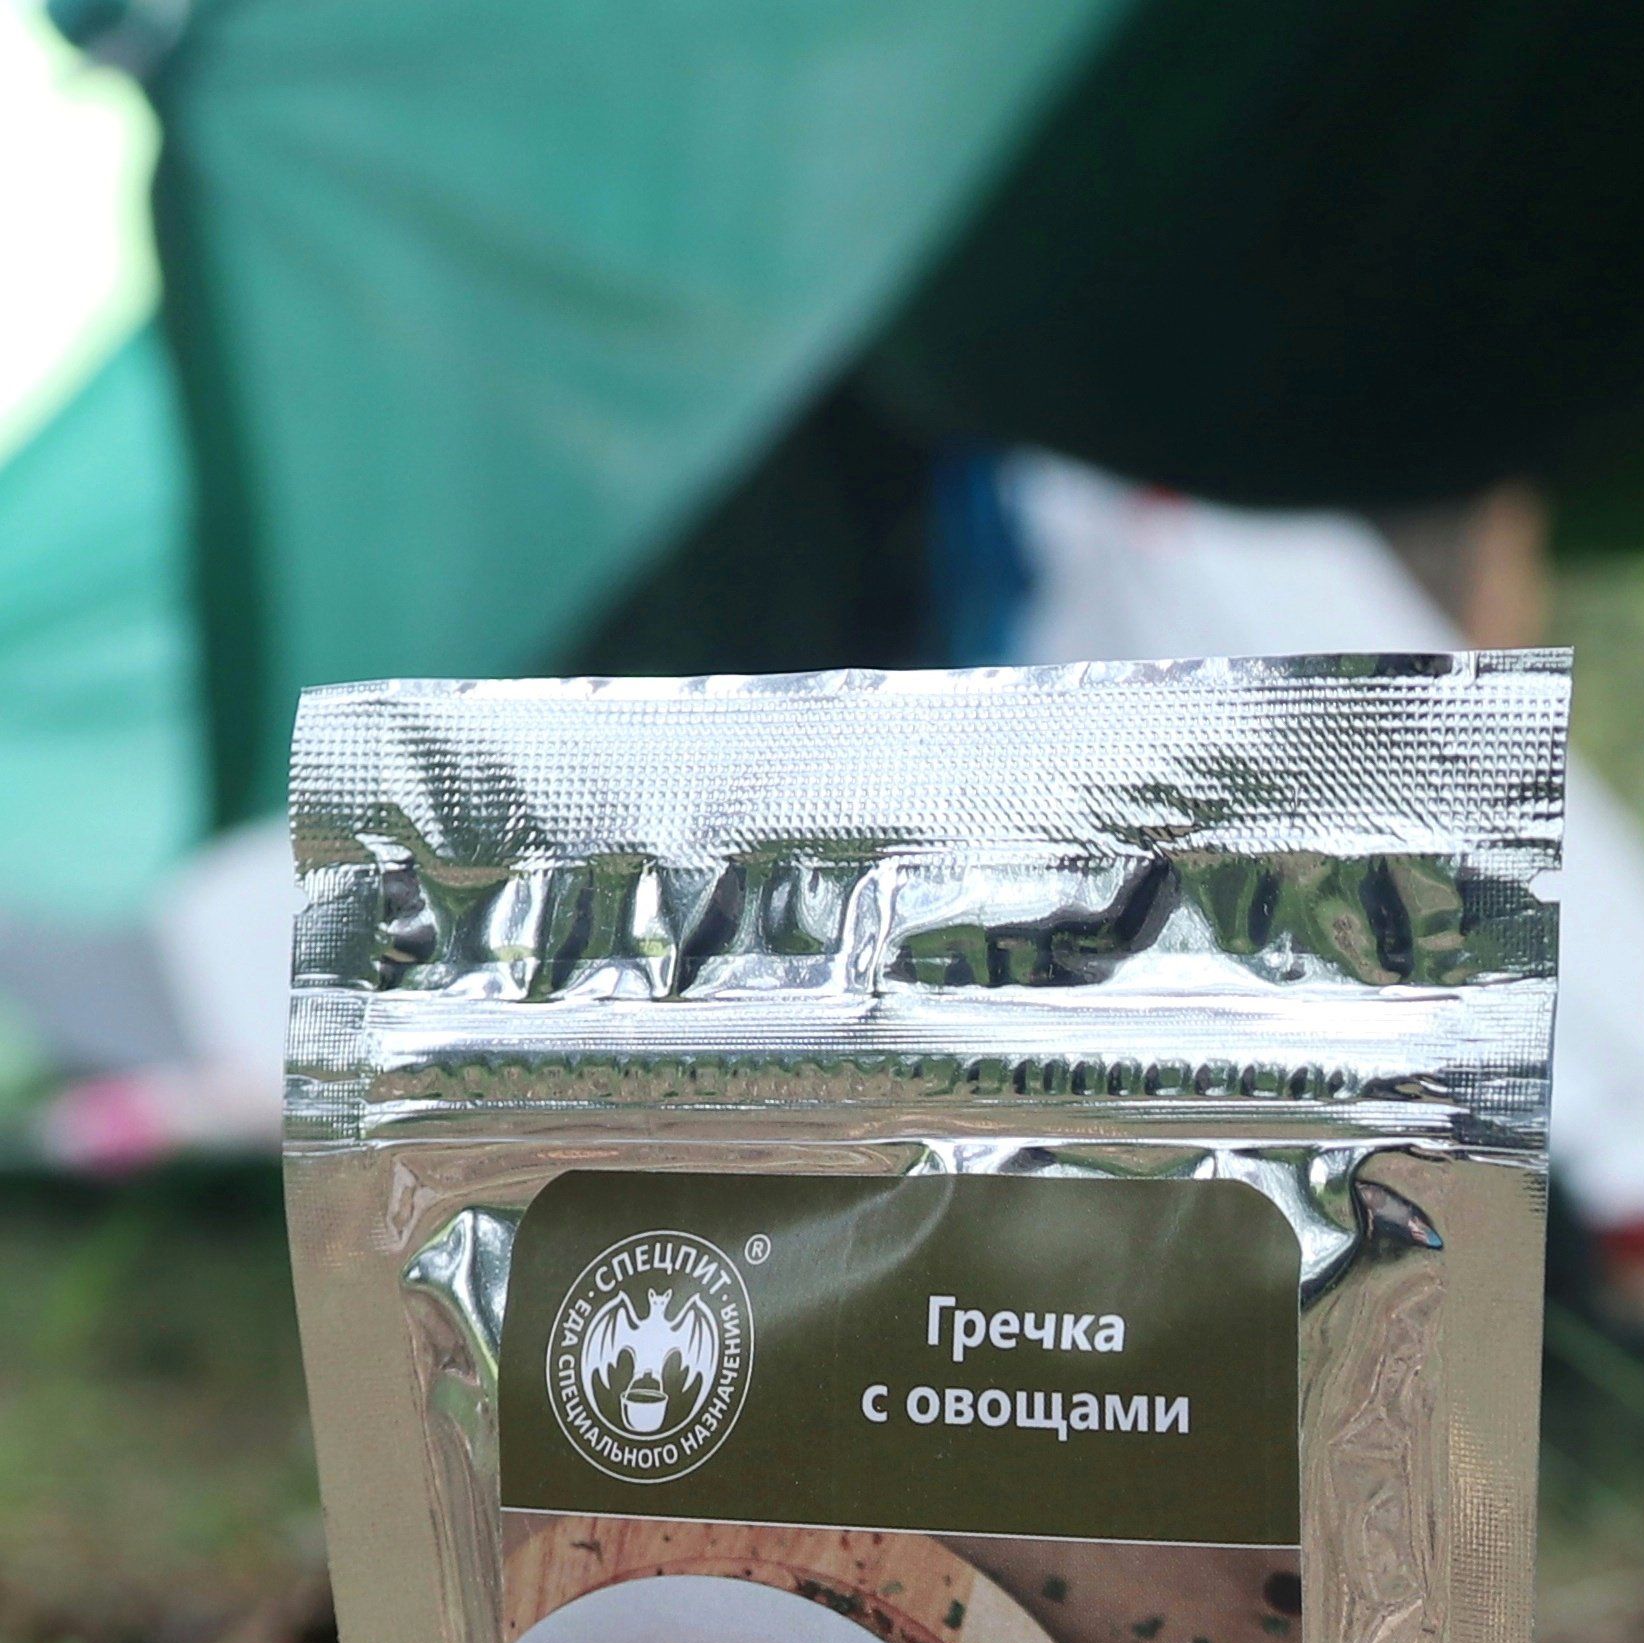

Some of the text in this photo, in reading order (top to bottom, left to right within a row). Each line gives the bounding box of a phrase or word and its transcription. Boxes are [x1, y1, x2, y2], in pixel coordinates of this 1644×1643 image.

[595, 1242, 732, 1295] СПЕЦПИТ
[928, 1296, 1125, 1362] Гречка
[558, 1298, 741, 1468] ЕДА СПЕЦИАЛЬНОГО НАЗНАЧЕНИЯ
[862, 1385, 1188, 1441] с овощами
